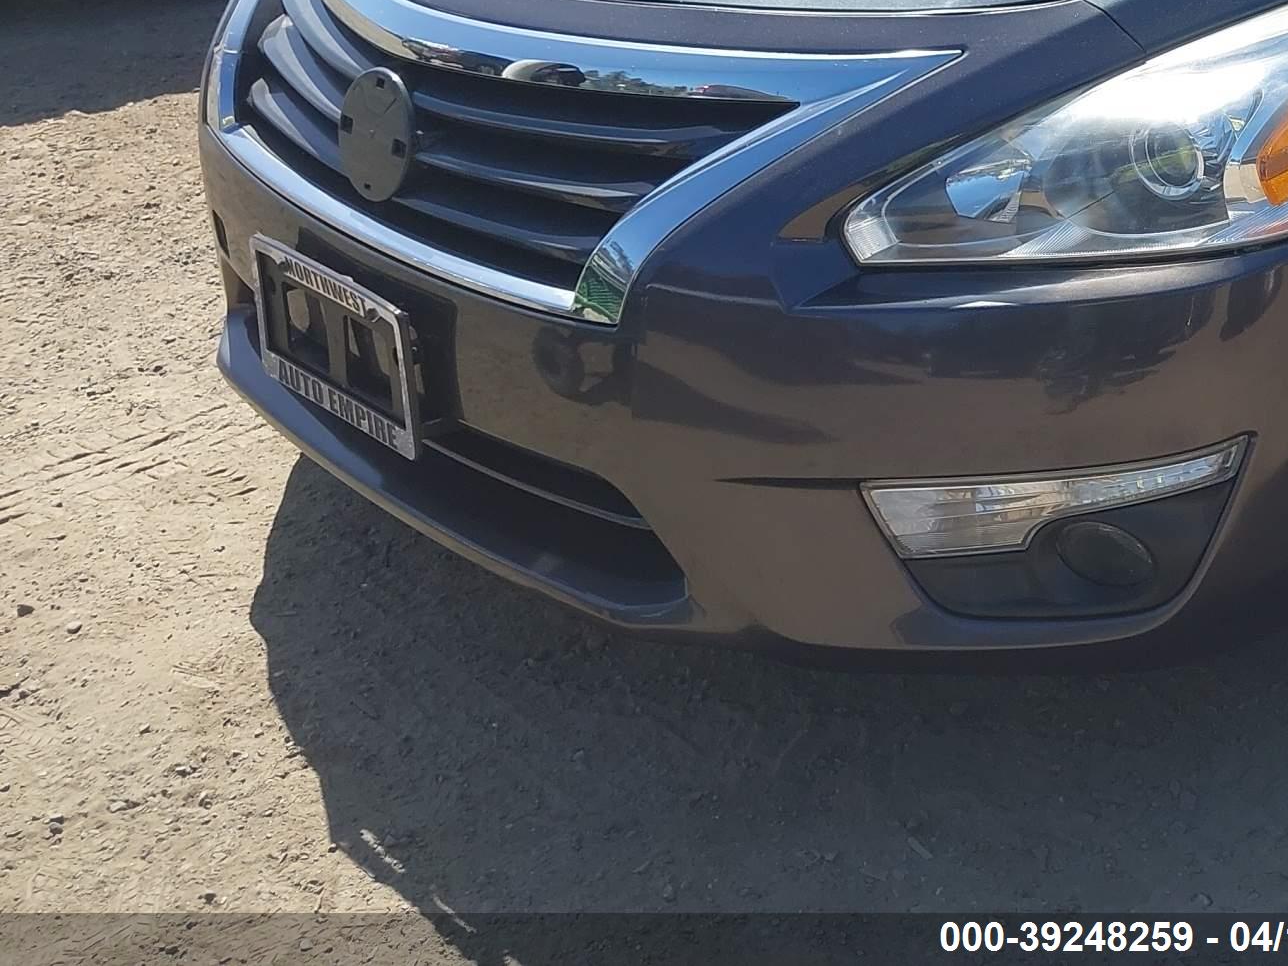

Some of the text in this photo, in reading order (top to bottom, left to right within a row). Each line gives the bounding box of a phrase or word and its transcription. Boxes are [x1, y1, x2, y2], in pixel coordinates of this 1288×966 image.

[284, 256, 367, 314] NORTHWEST
[278, 360, 399, 449] AUTO EMPIRE
